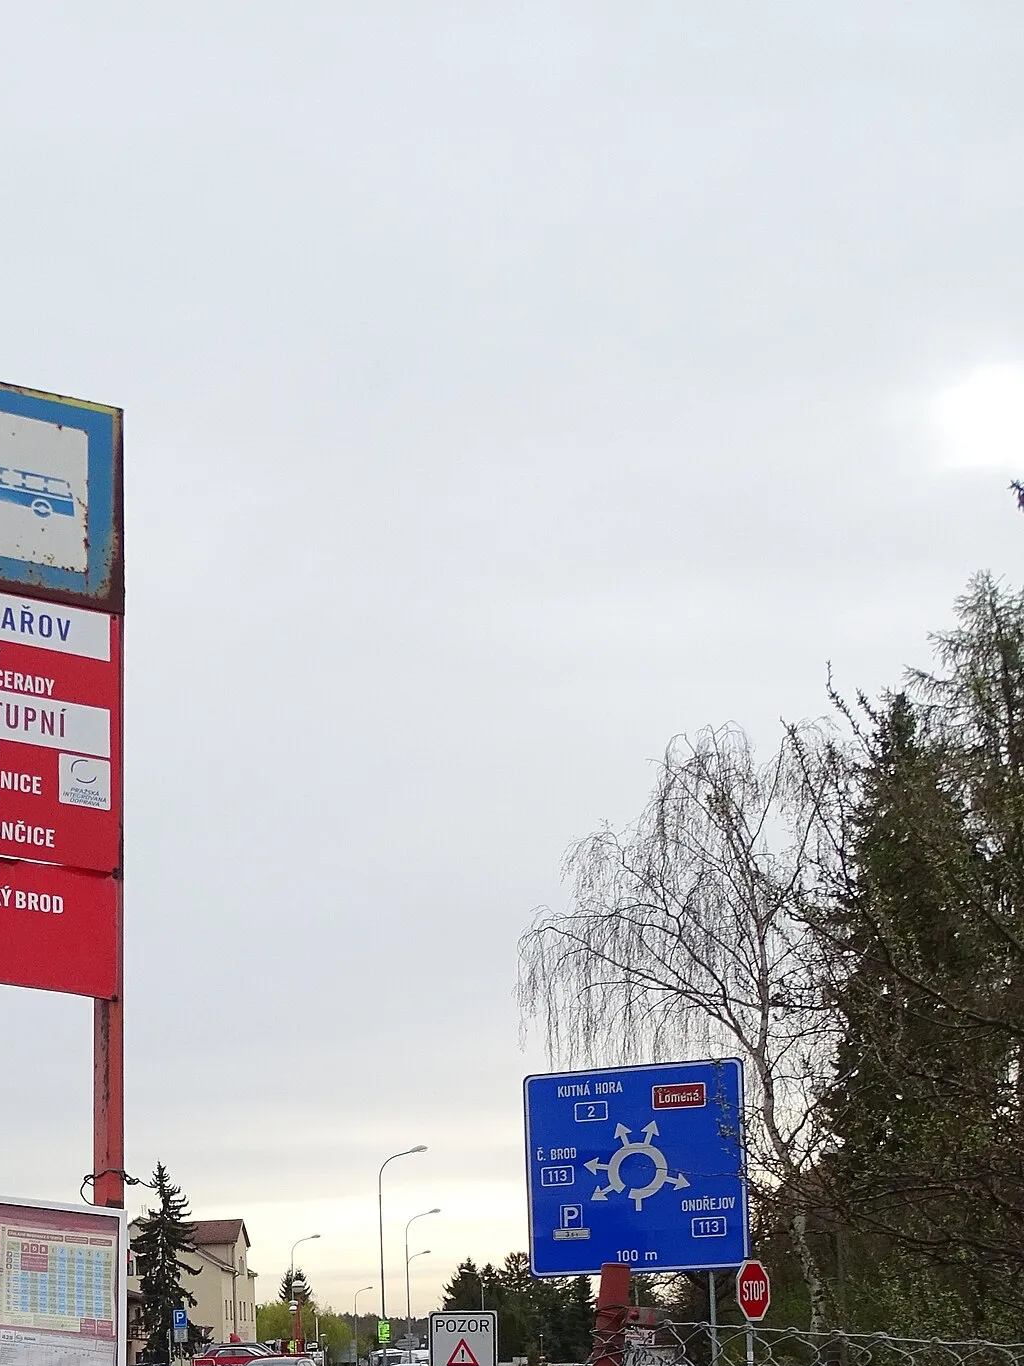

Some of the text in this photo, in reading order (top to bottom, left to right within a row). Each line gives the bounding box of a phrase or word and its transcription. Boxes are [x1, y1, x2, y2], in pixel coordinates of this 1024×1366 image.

[15, 890, 64, 914] BROD
[557, 1080, 623, 1098] KUTNÁ HORA
[587, 1106, 596, 1117] 2
[537, 1146, 576, 1162] Č. BROD
[548, 1170, 568, 1182] 113
[682, 1195, 736, 1212] ONDŘEJOV
[564, 1206, 578, 1228] P
[698, 1221, 719, 1234] 113
[616, 1250, 658, 1262] 100 m
[742, 1280, 766, 1302] STOP
[176, 1312, 184, 1323] P
[436, 1319, 490, 1332] POZOR
